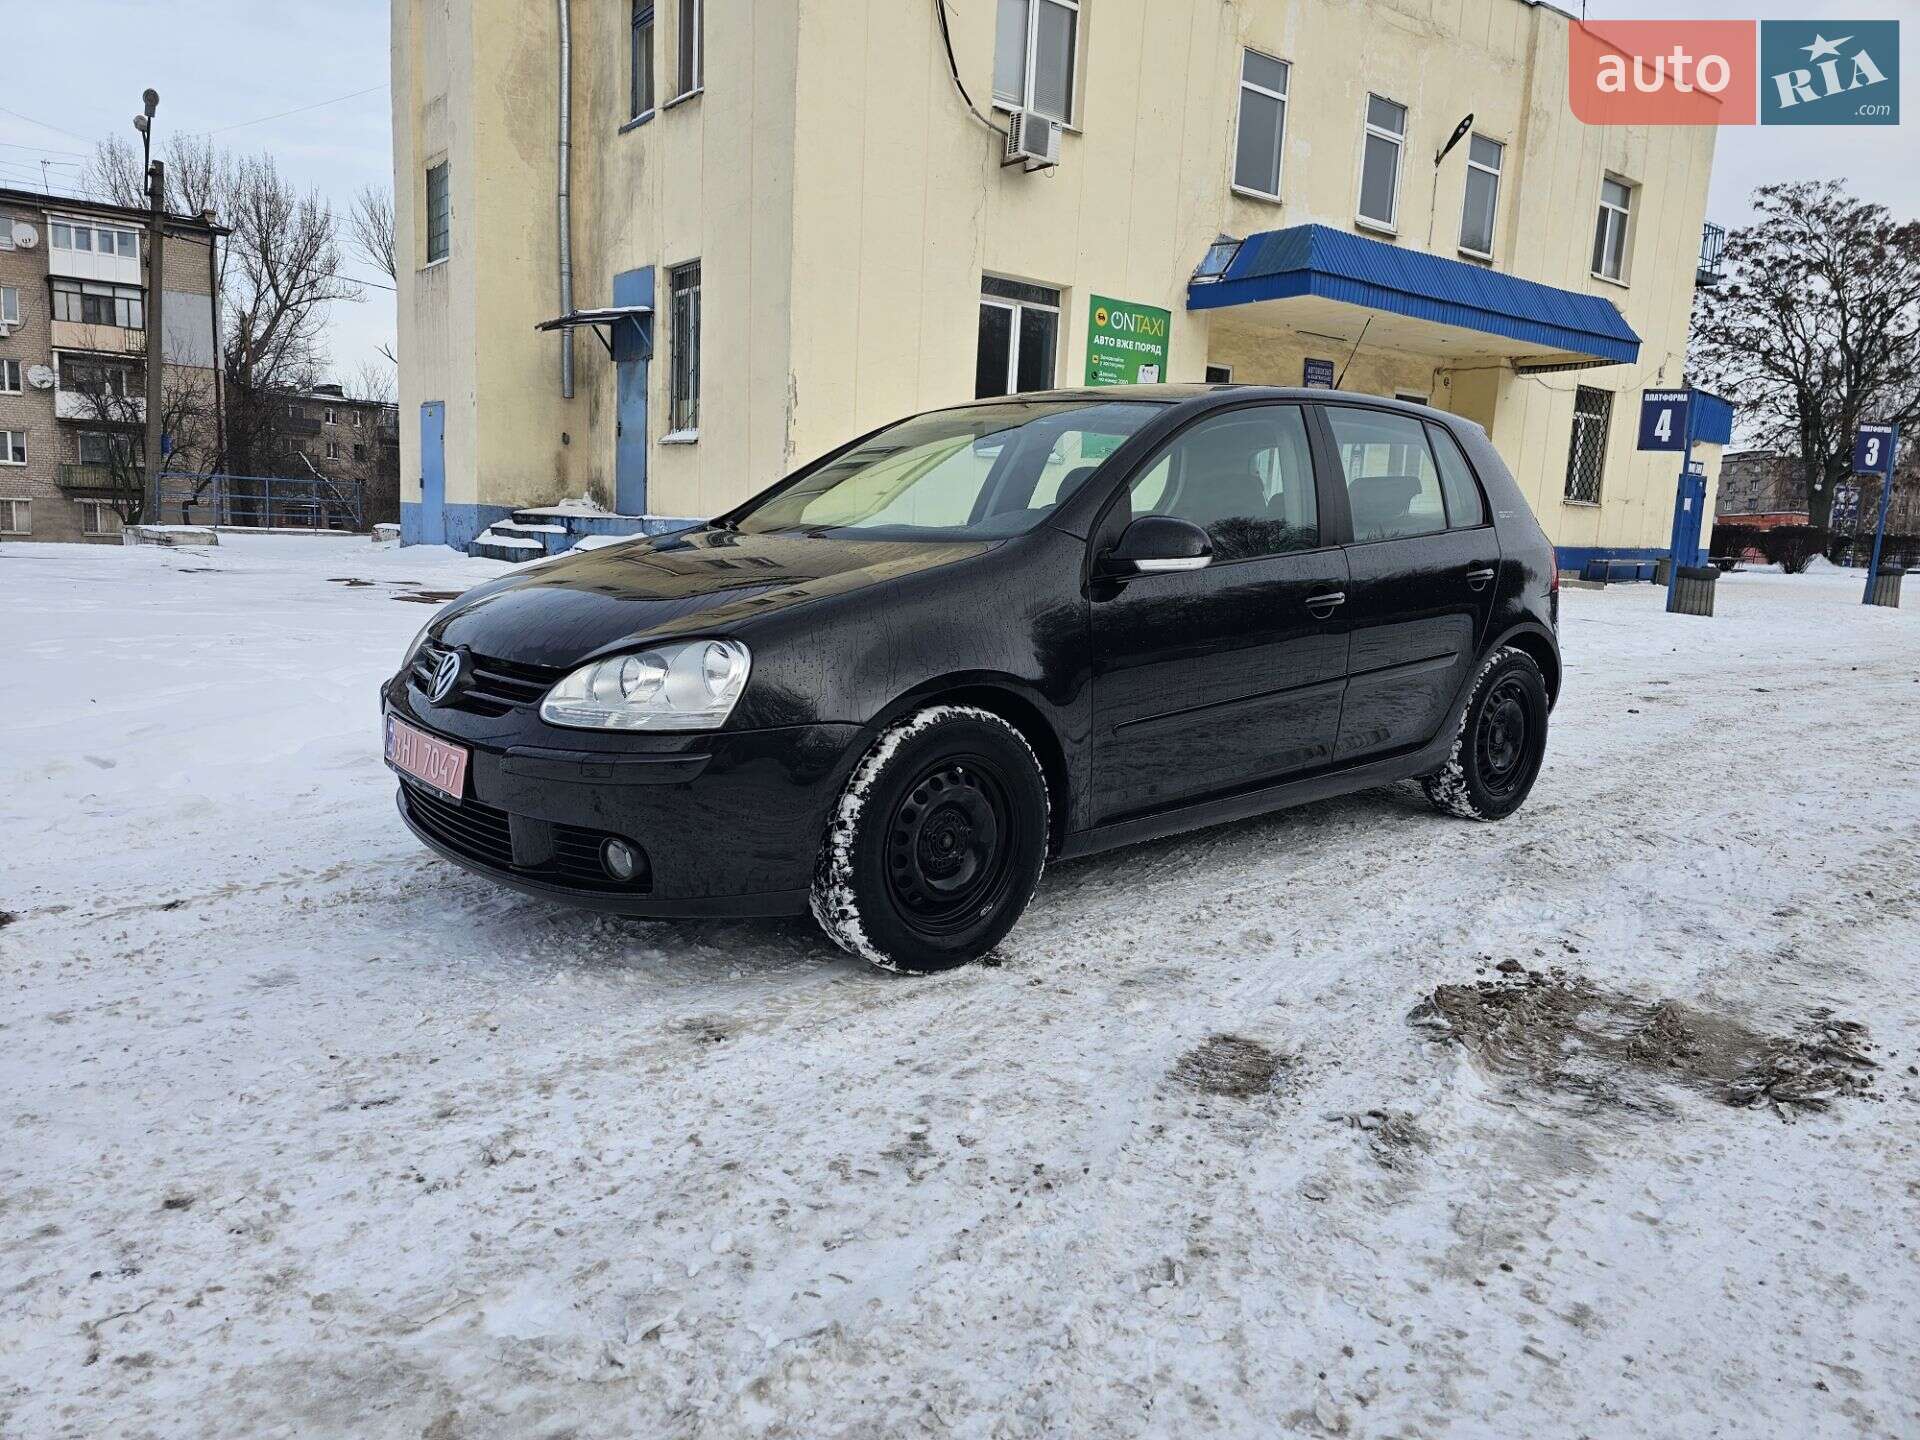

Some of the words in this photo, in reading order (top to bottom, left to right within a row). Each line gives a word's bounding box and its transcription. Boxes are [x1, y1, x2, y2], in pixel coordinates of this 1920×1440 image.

[1111, 311, 1164, 337] ONTAXI
[1094, 334, 1115, 347] АВТО
[1116, 338, 1134, 350] ВЖЕ
[1135, 341, 1162, 356] ПОРЯД
[1644, 393, 1688, 402] ПЛАТФОРМА
[1654, 409, 1672, 442] 4
[1865, 437, 1880, 467] 3
[422, 743, 460, 788] 7047
